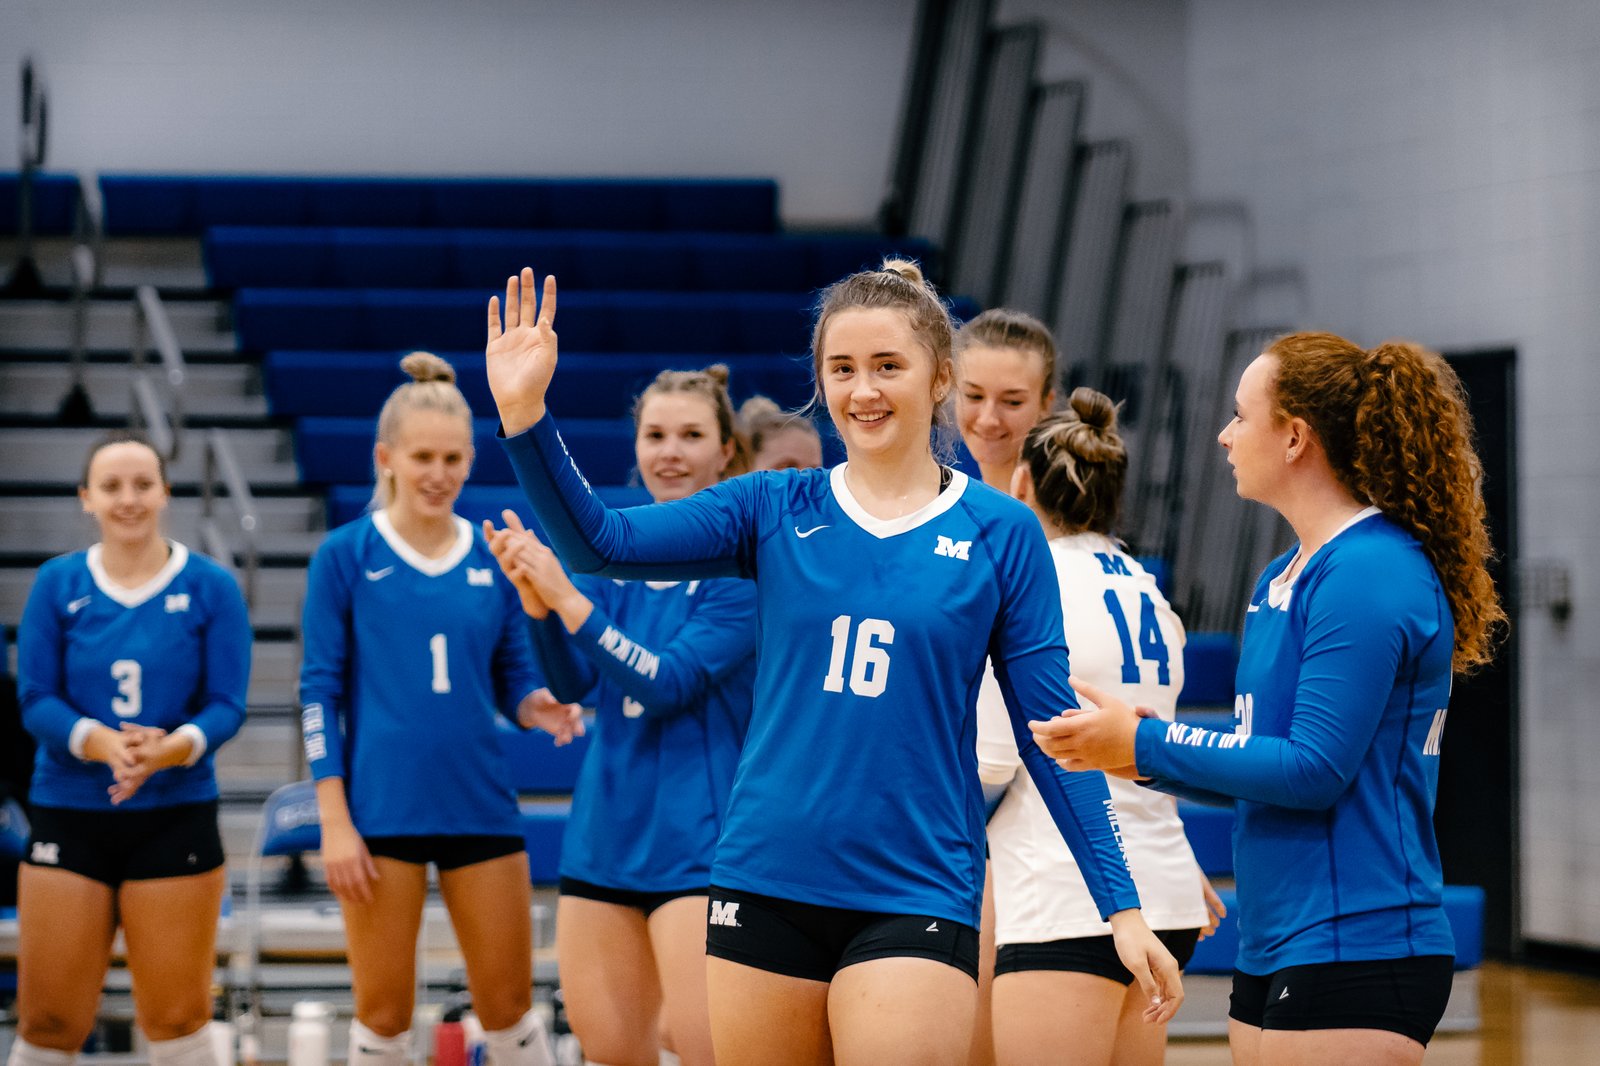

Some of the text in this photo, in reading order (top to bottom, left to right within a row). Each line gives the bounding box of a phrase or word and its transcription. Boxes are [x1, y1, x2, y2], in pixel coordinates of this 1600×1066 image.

[934, 535, 972, 561] M
[1093, 552, 1133, 577] M
[430, 633, 451, 694] 1
[823, 614, 896, 698] 16
[1103, 589, 1170, 686] 14
[111, 659, 142, 718] 3
[710, 900, 740, 927] M
